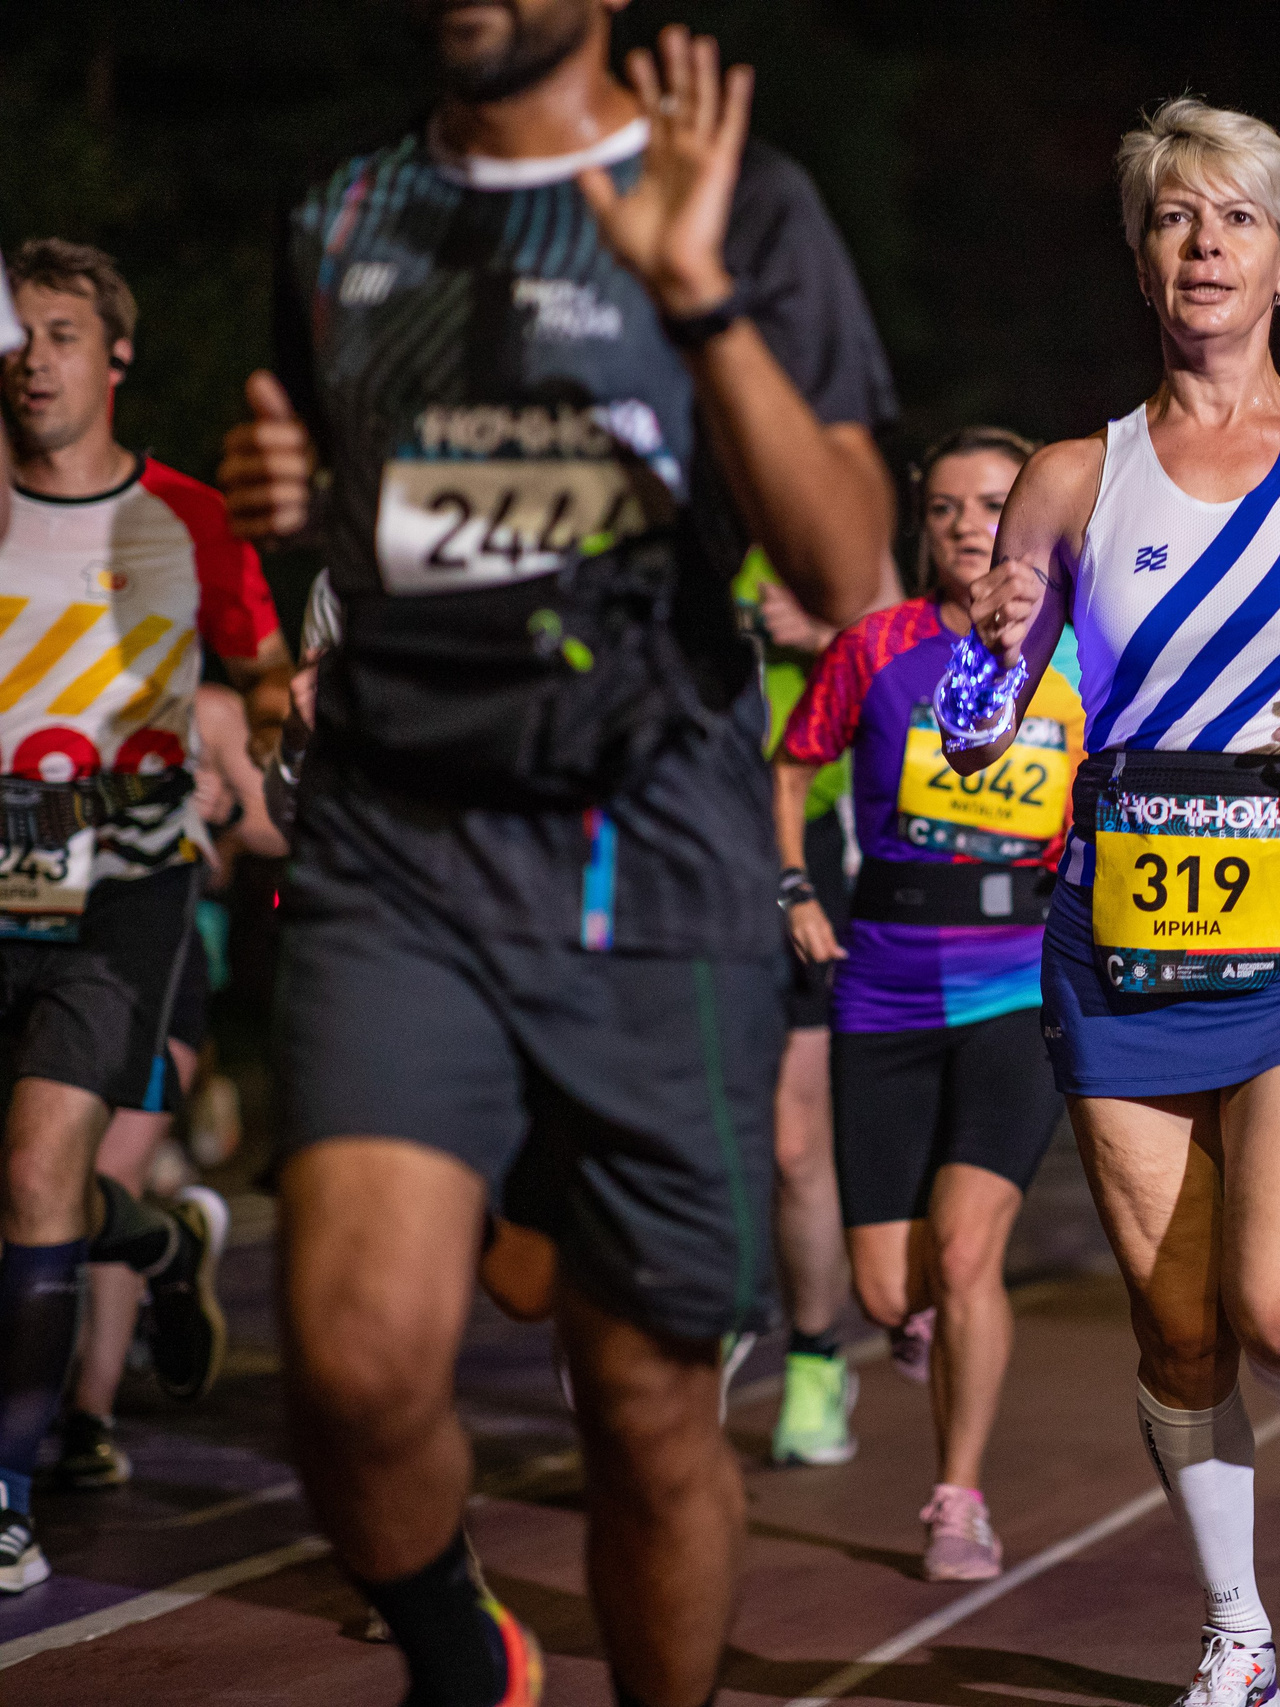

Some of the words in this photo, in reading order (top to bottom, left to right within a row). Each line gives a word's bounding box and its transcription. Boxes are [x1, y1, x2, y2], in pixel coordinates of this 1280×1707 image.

[1189, 828, 1254, 839] ЗАБЕГ
[1132, 853, 1251, 914] 319
[1153, 920, 1222, 937] ИРИНА
